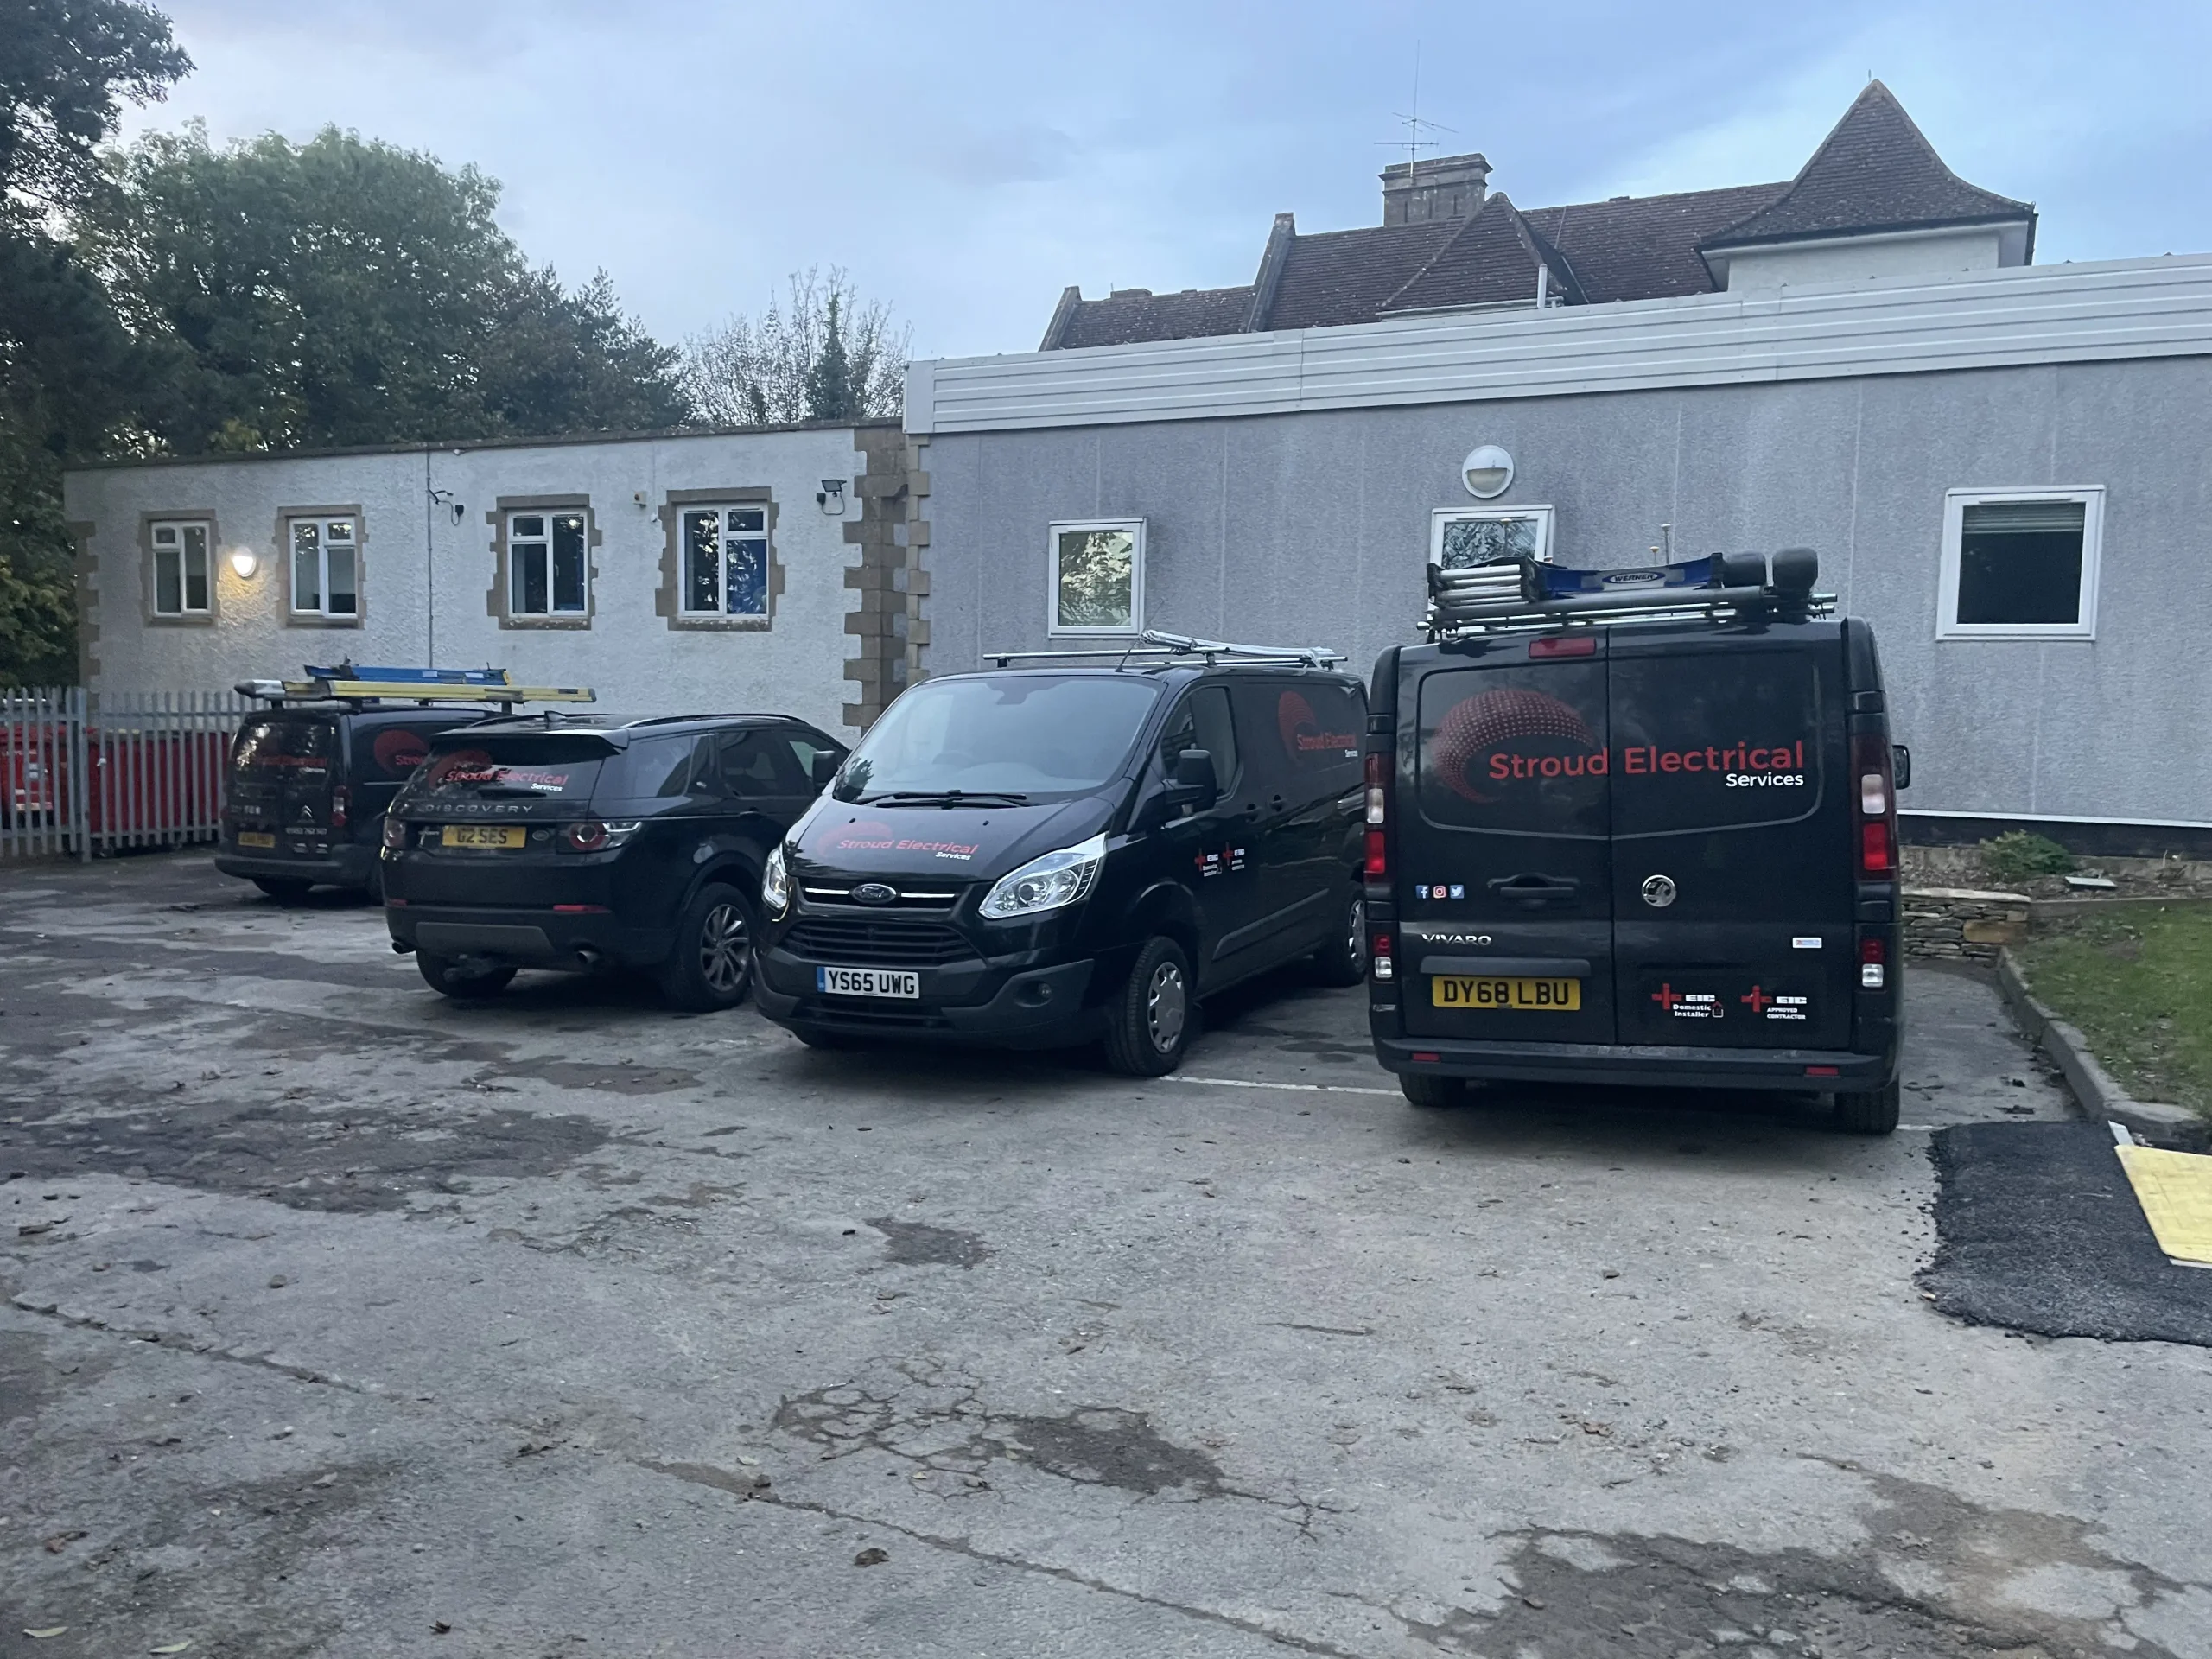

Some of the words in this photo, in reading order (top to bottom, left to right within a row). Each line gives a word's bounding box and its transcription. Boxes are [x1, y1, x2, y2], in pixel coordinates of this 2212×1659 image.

[1614, 574, 1654, 582] WERNER
[1488, 747, 1609, 779] Stroud
[1624, 740, 1804, 774] Electrical
[445, 769, 493, 783] Stroud
[496, 769, 569, 785] Electrical
[1726, 771, 1804, 787] Services
[530, 782, 563, 792] Services
[425, 804, 534, 815] DISCOVERY
[456, 829, 475, 843] G2
[479, 829, 509, 844] SES
[836, 839, 895, 849] Stroud
[895, 839, 979, 855] Electrical
[935, 851, 972, 861] Services
[1421, 933, 1492, 946] VIVARO
[829, 970, 874, 992] YS65
[879, 973, 915, 995] UWG
[1443, 980, 1510, 1004] DY68
[1517, 981, 1569, 1005] LBU
[1672, 1003, 1712, 1012] Domestic
